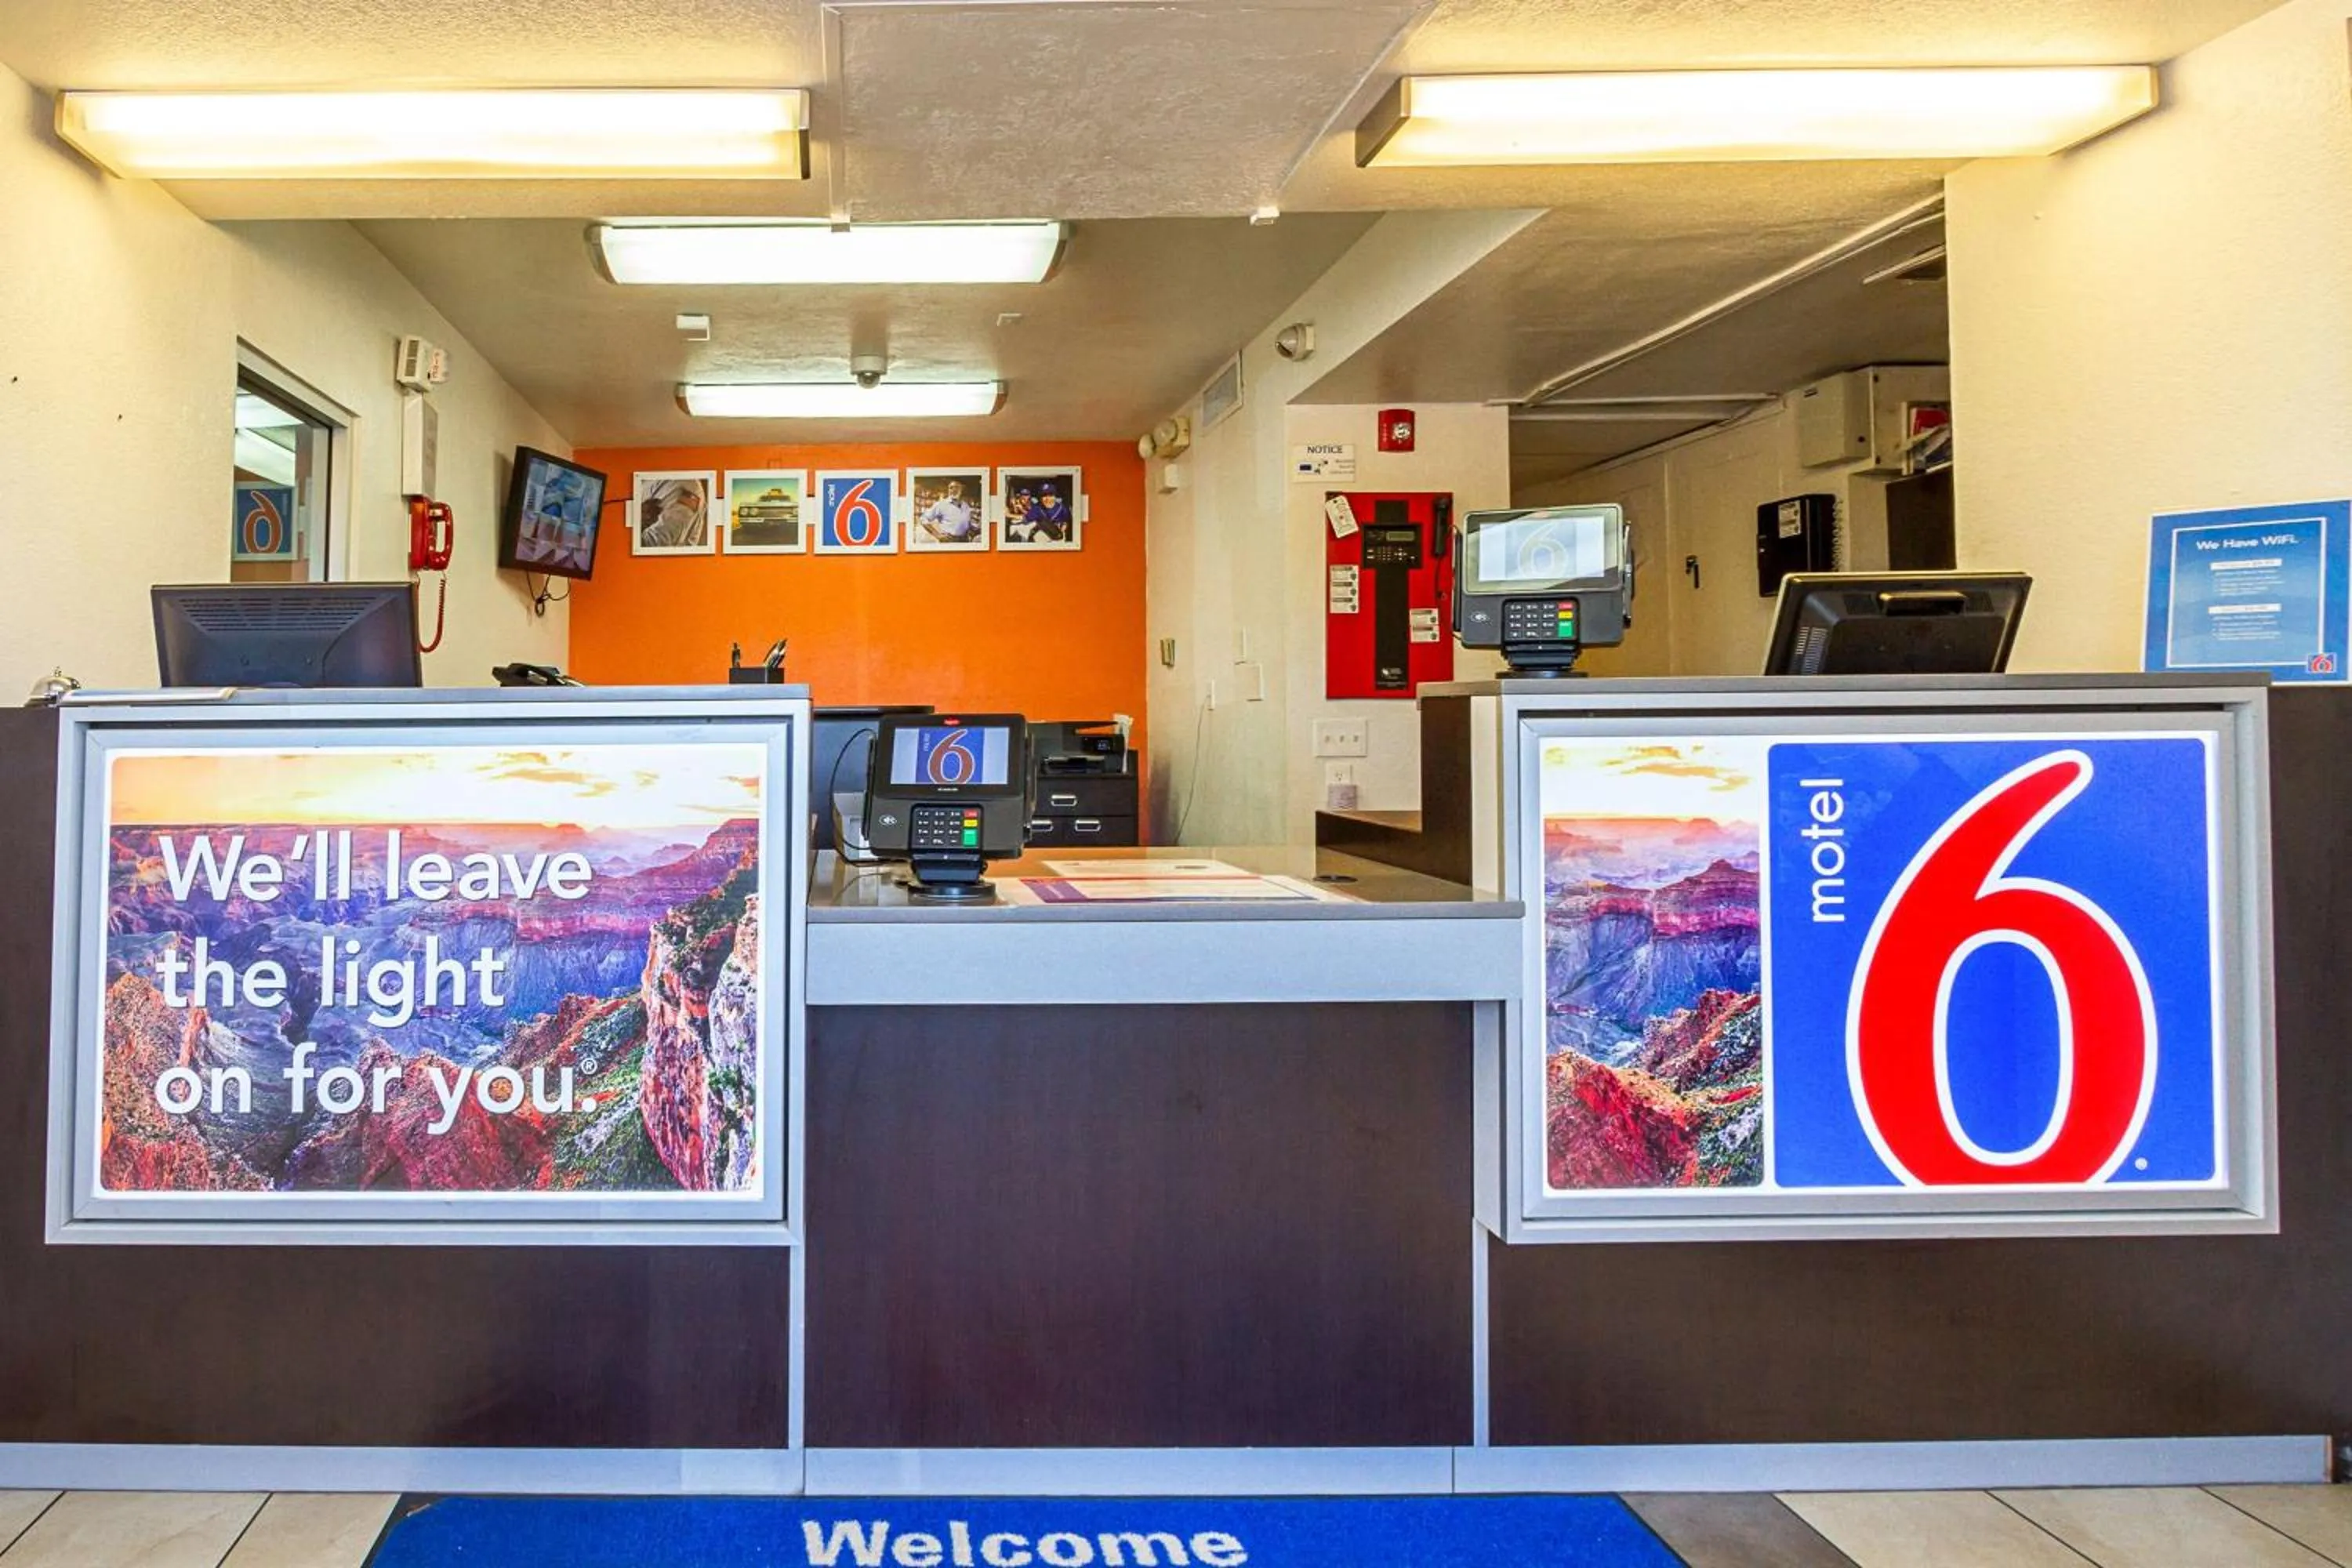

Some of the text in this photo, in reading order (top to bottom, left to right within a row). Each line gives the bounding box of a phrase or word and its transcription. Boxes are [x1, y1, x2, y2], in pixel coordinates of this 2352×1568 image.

[1307, 445, 1343, 454] NOTICE
[834, 480, 882, 546] 6
[2196, 540, 2220, 550] We
[2223, 539, 2258, 549] Have
[927, 729, 975, 784] 6
[158, 829, 592, 902] We’ll leave
[155, 935, 506, 1027] the light
[1799, 749, 2158, 1186] motel 6
[156, 1064, 252, 1114] on
[283, 1041, 402, 1114] for
[800, 1519, 1249, 1568] Welcome
